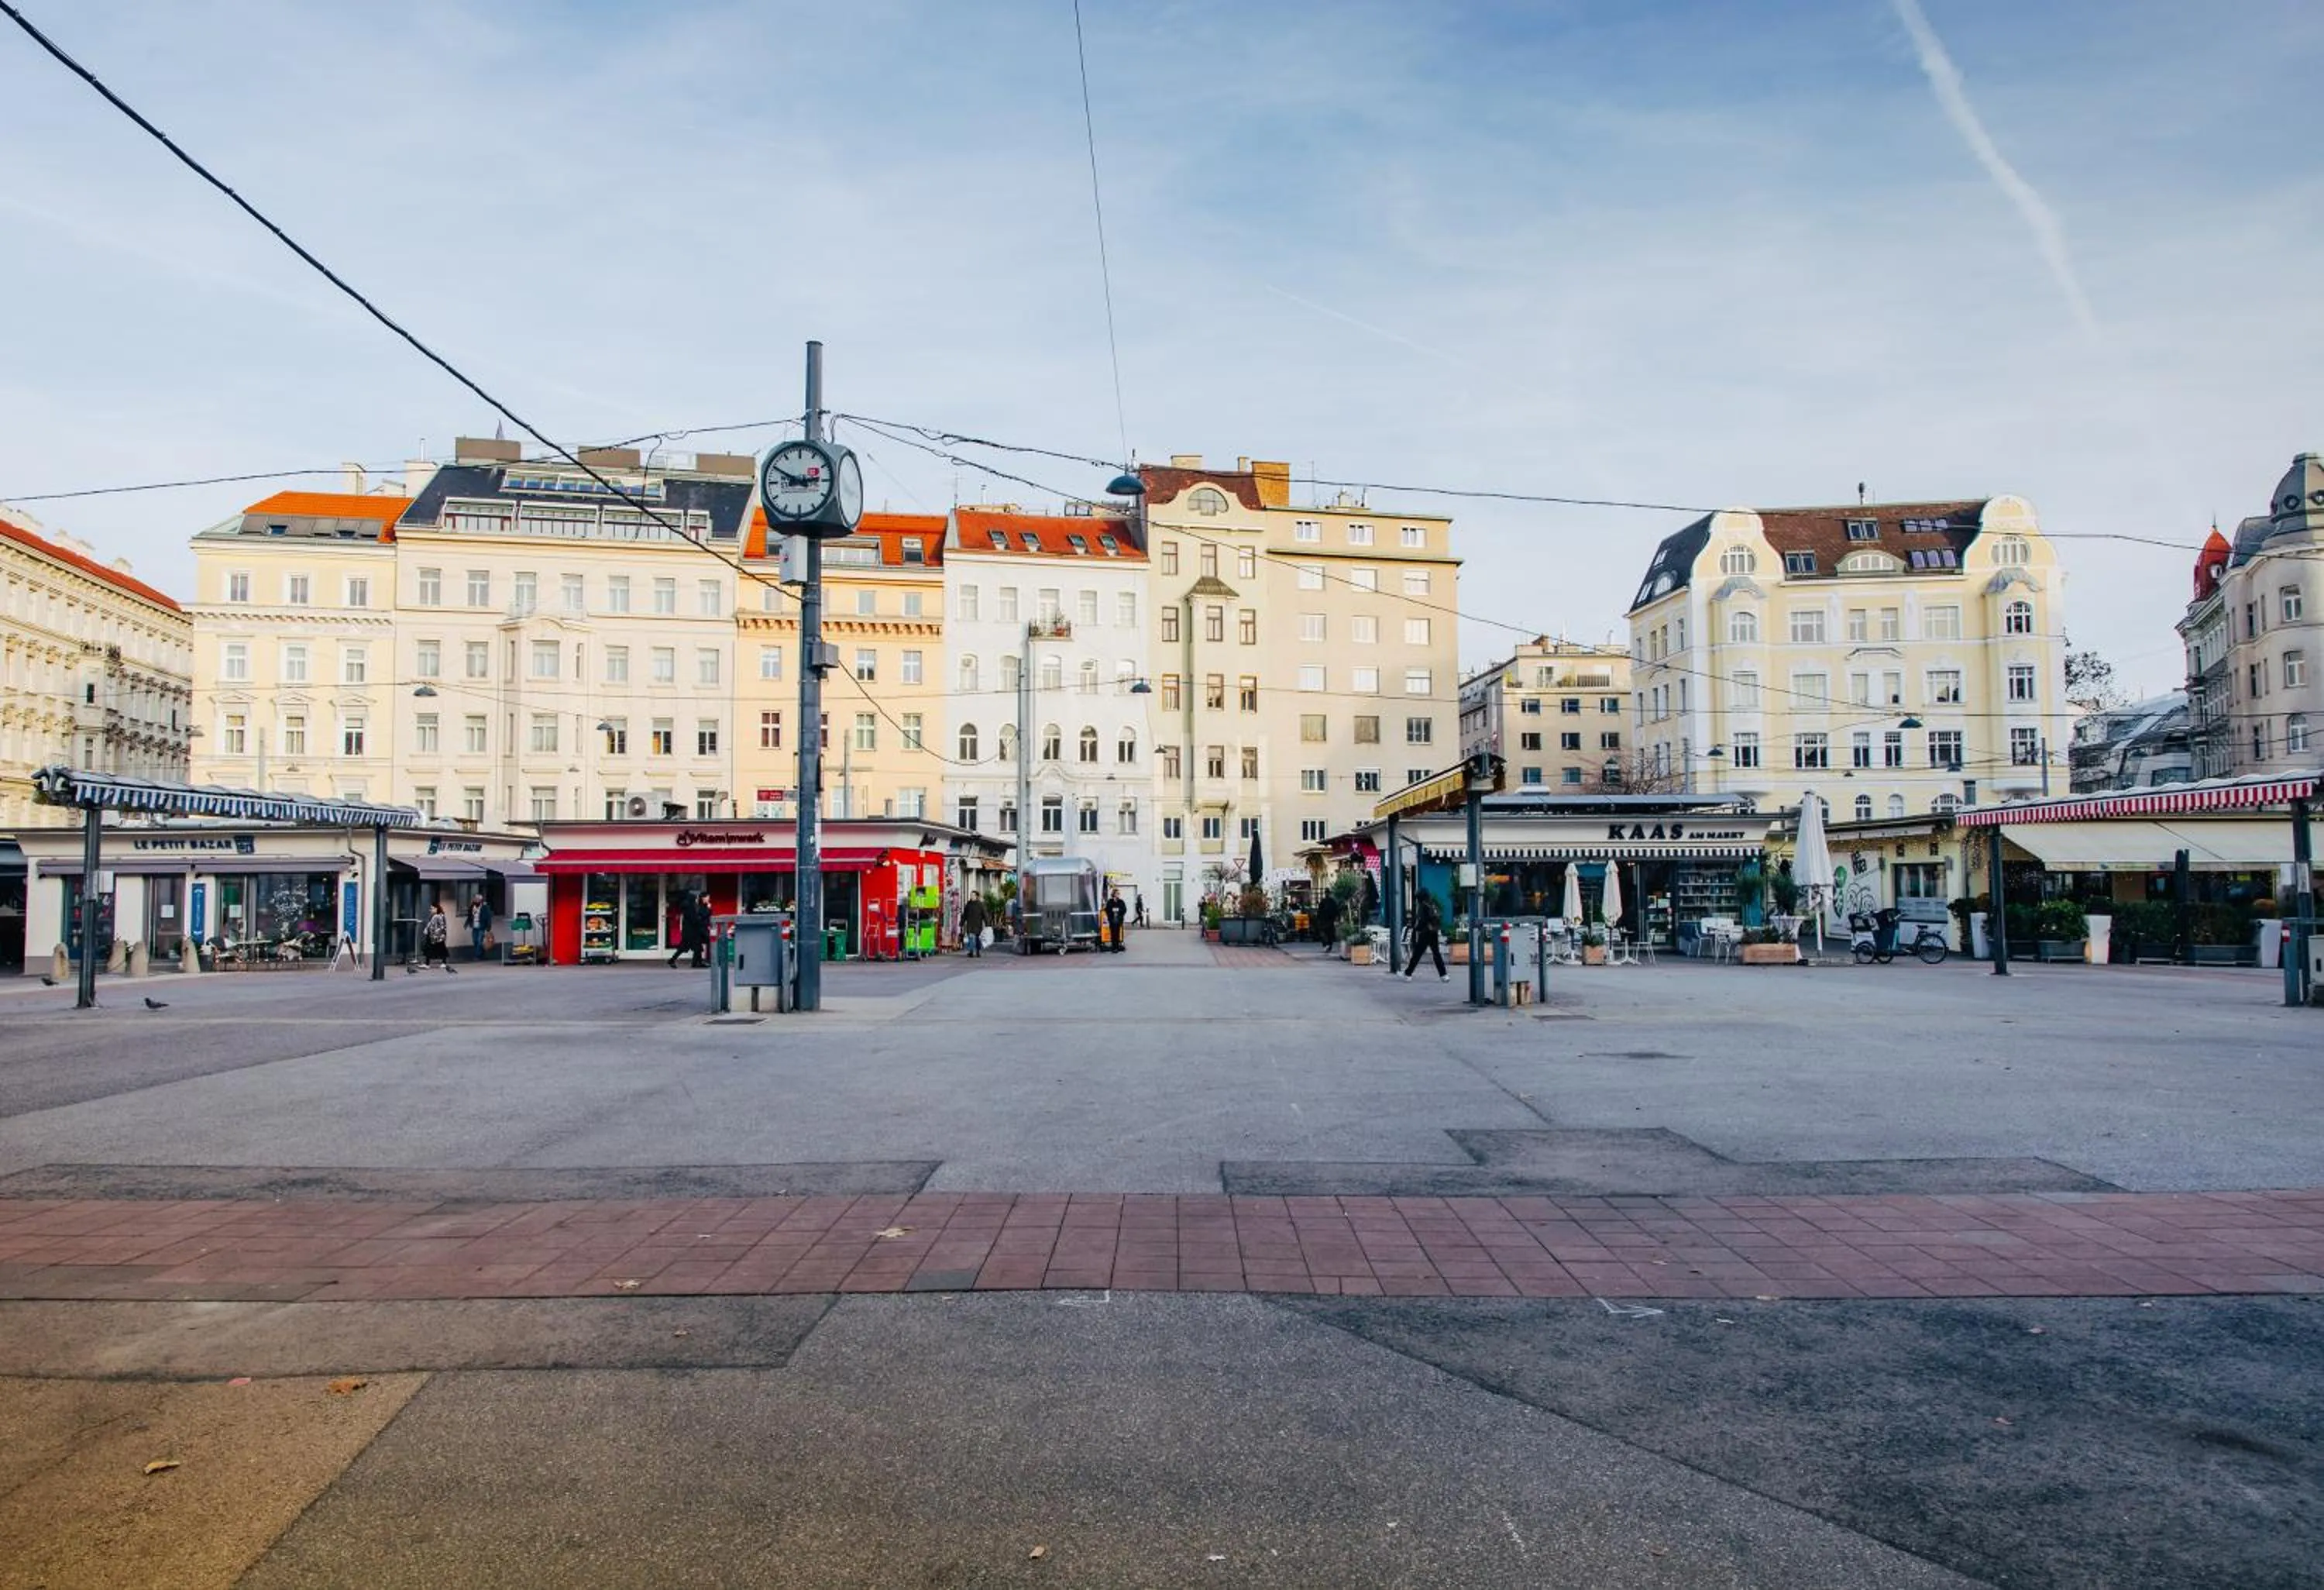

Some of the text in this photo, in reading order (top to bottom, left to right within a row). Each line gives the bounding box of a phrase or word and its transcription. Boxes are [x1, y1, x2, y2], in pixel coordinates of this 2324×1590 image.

[1607, 824, 1684, 840] KAAS
[134, 839, 233, 850] LE PETIT BAZAR
